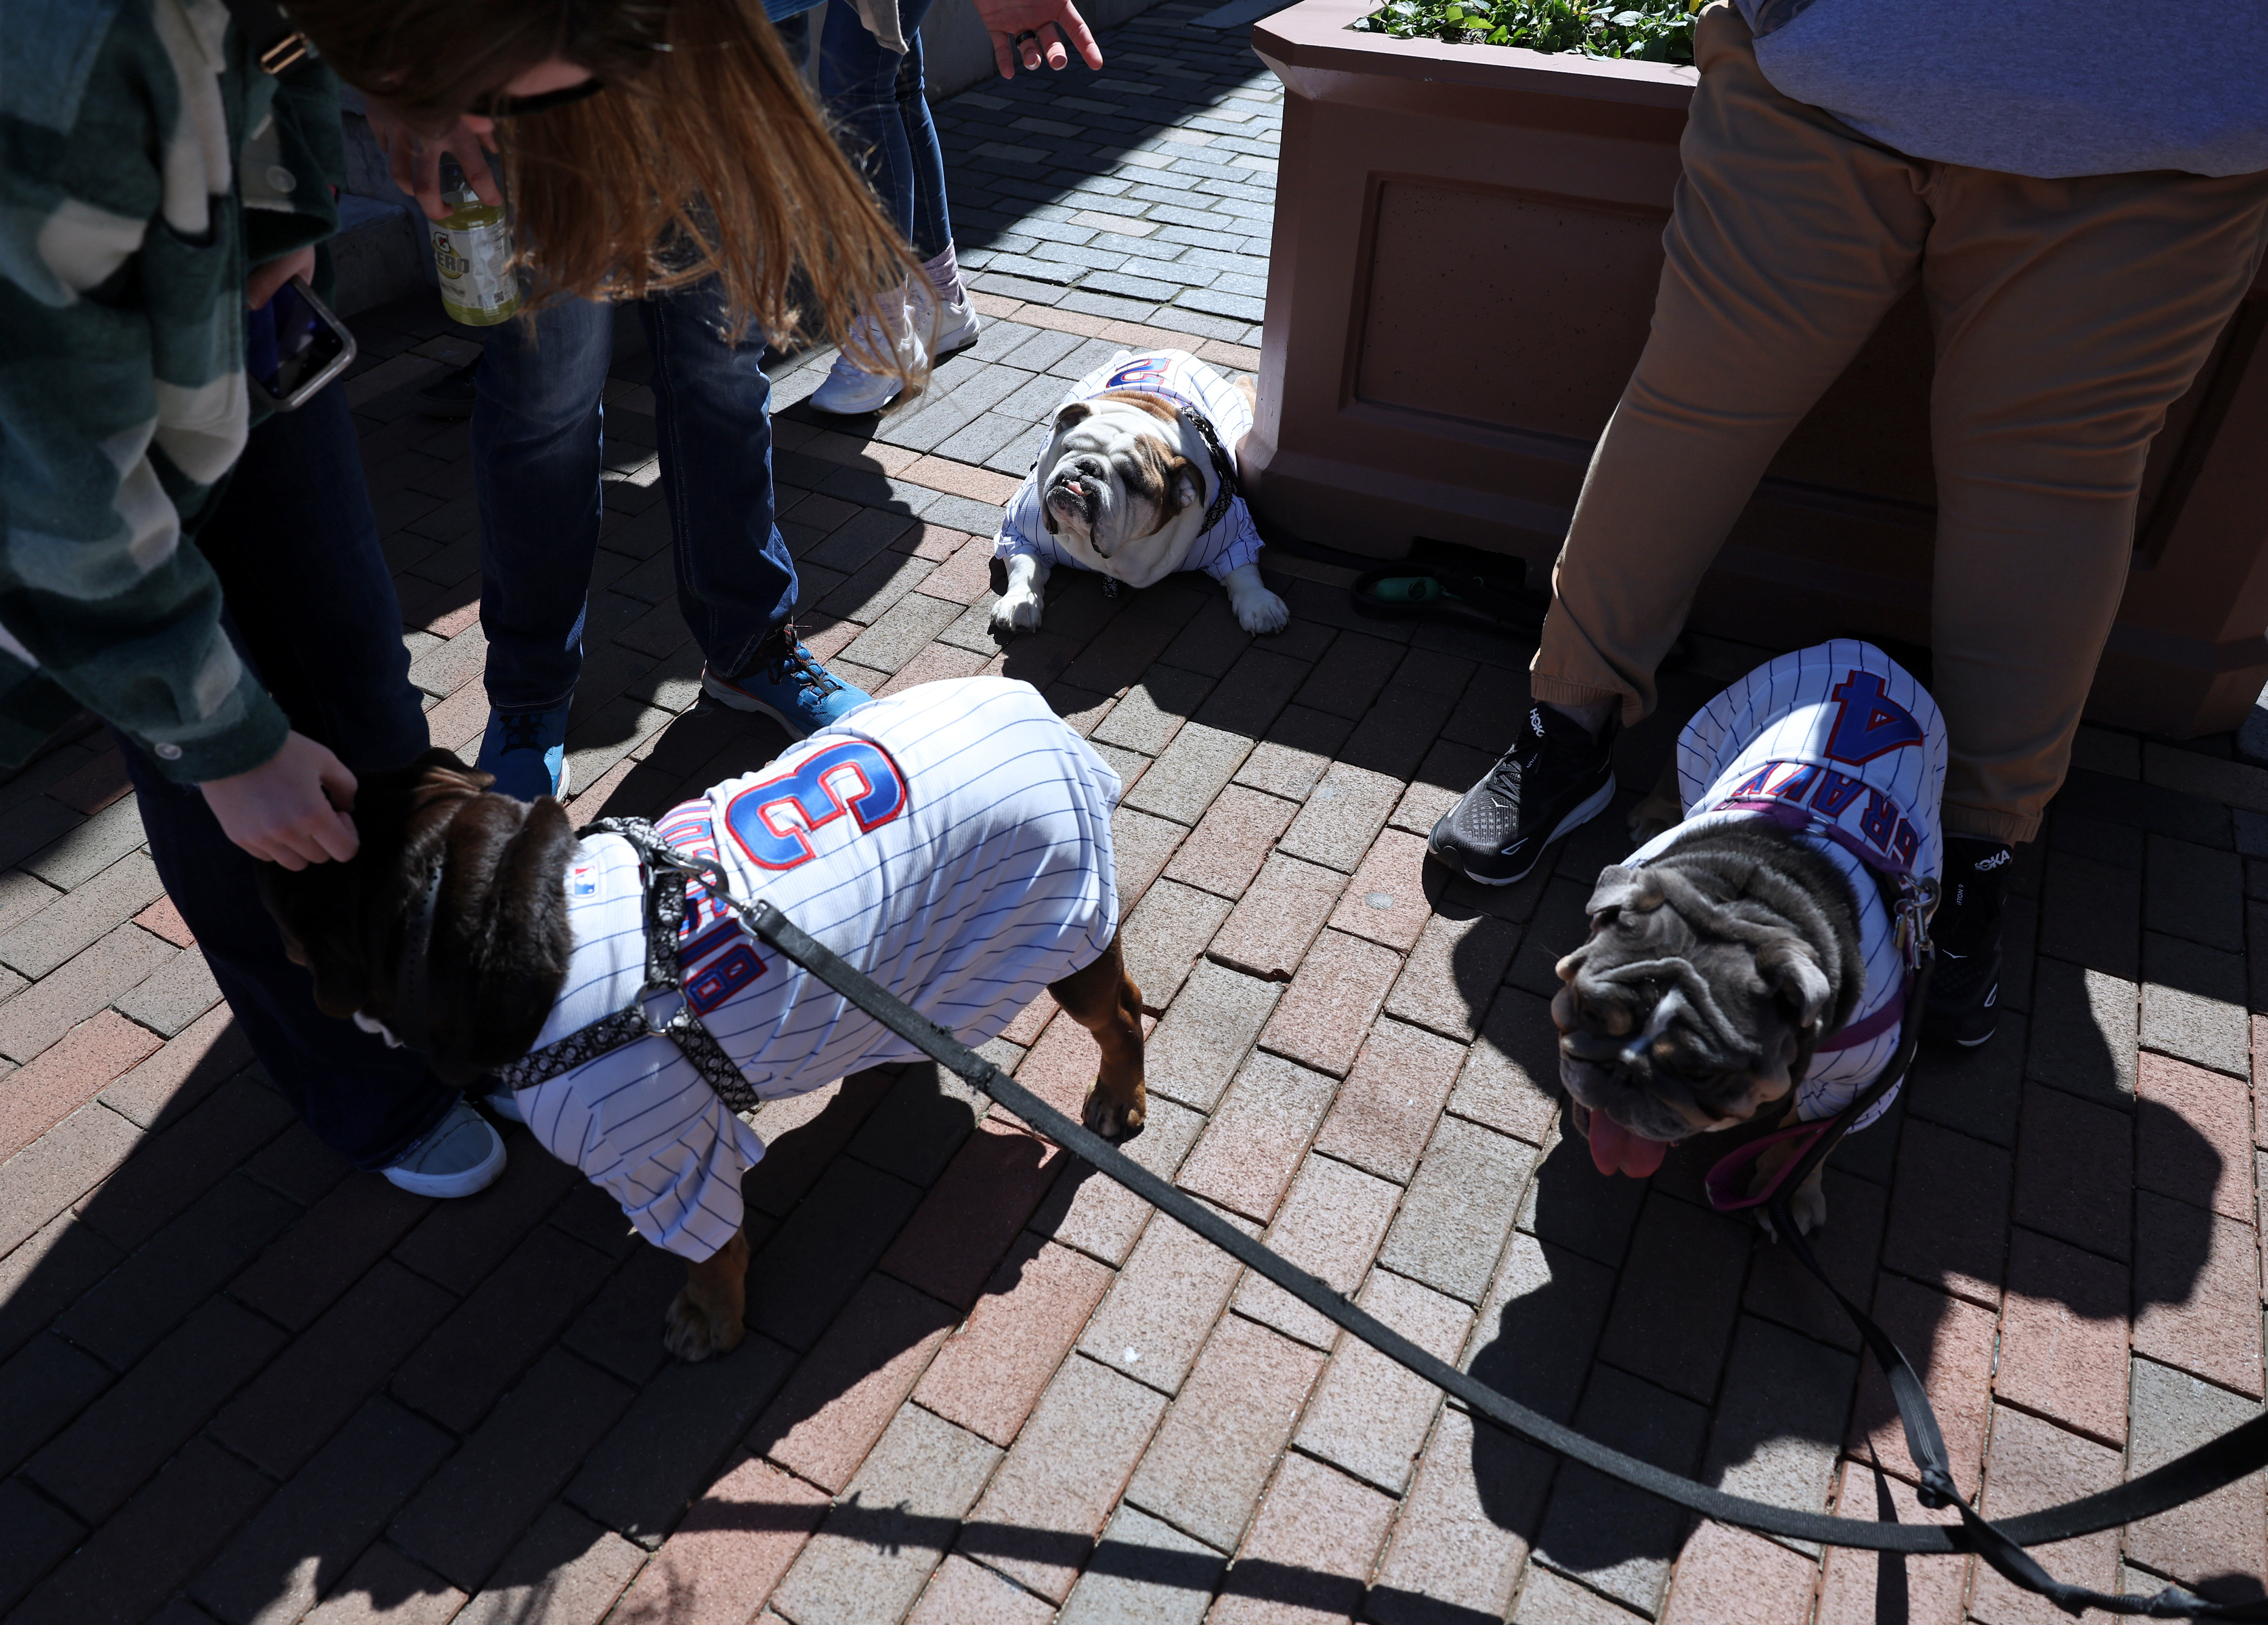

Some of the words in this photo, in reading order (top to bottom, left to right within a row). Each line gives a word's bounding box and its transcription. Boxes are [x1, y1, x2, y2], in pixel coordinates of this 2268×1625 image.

[436, 250, 469, 274] ERO
[1823, 669, 1924, 767] 4
[725, 741, 906, 870] 3
[1731, 761, 1918, 884] GRAVY
